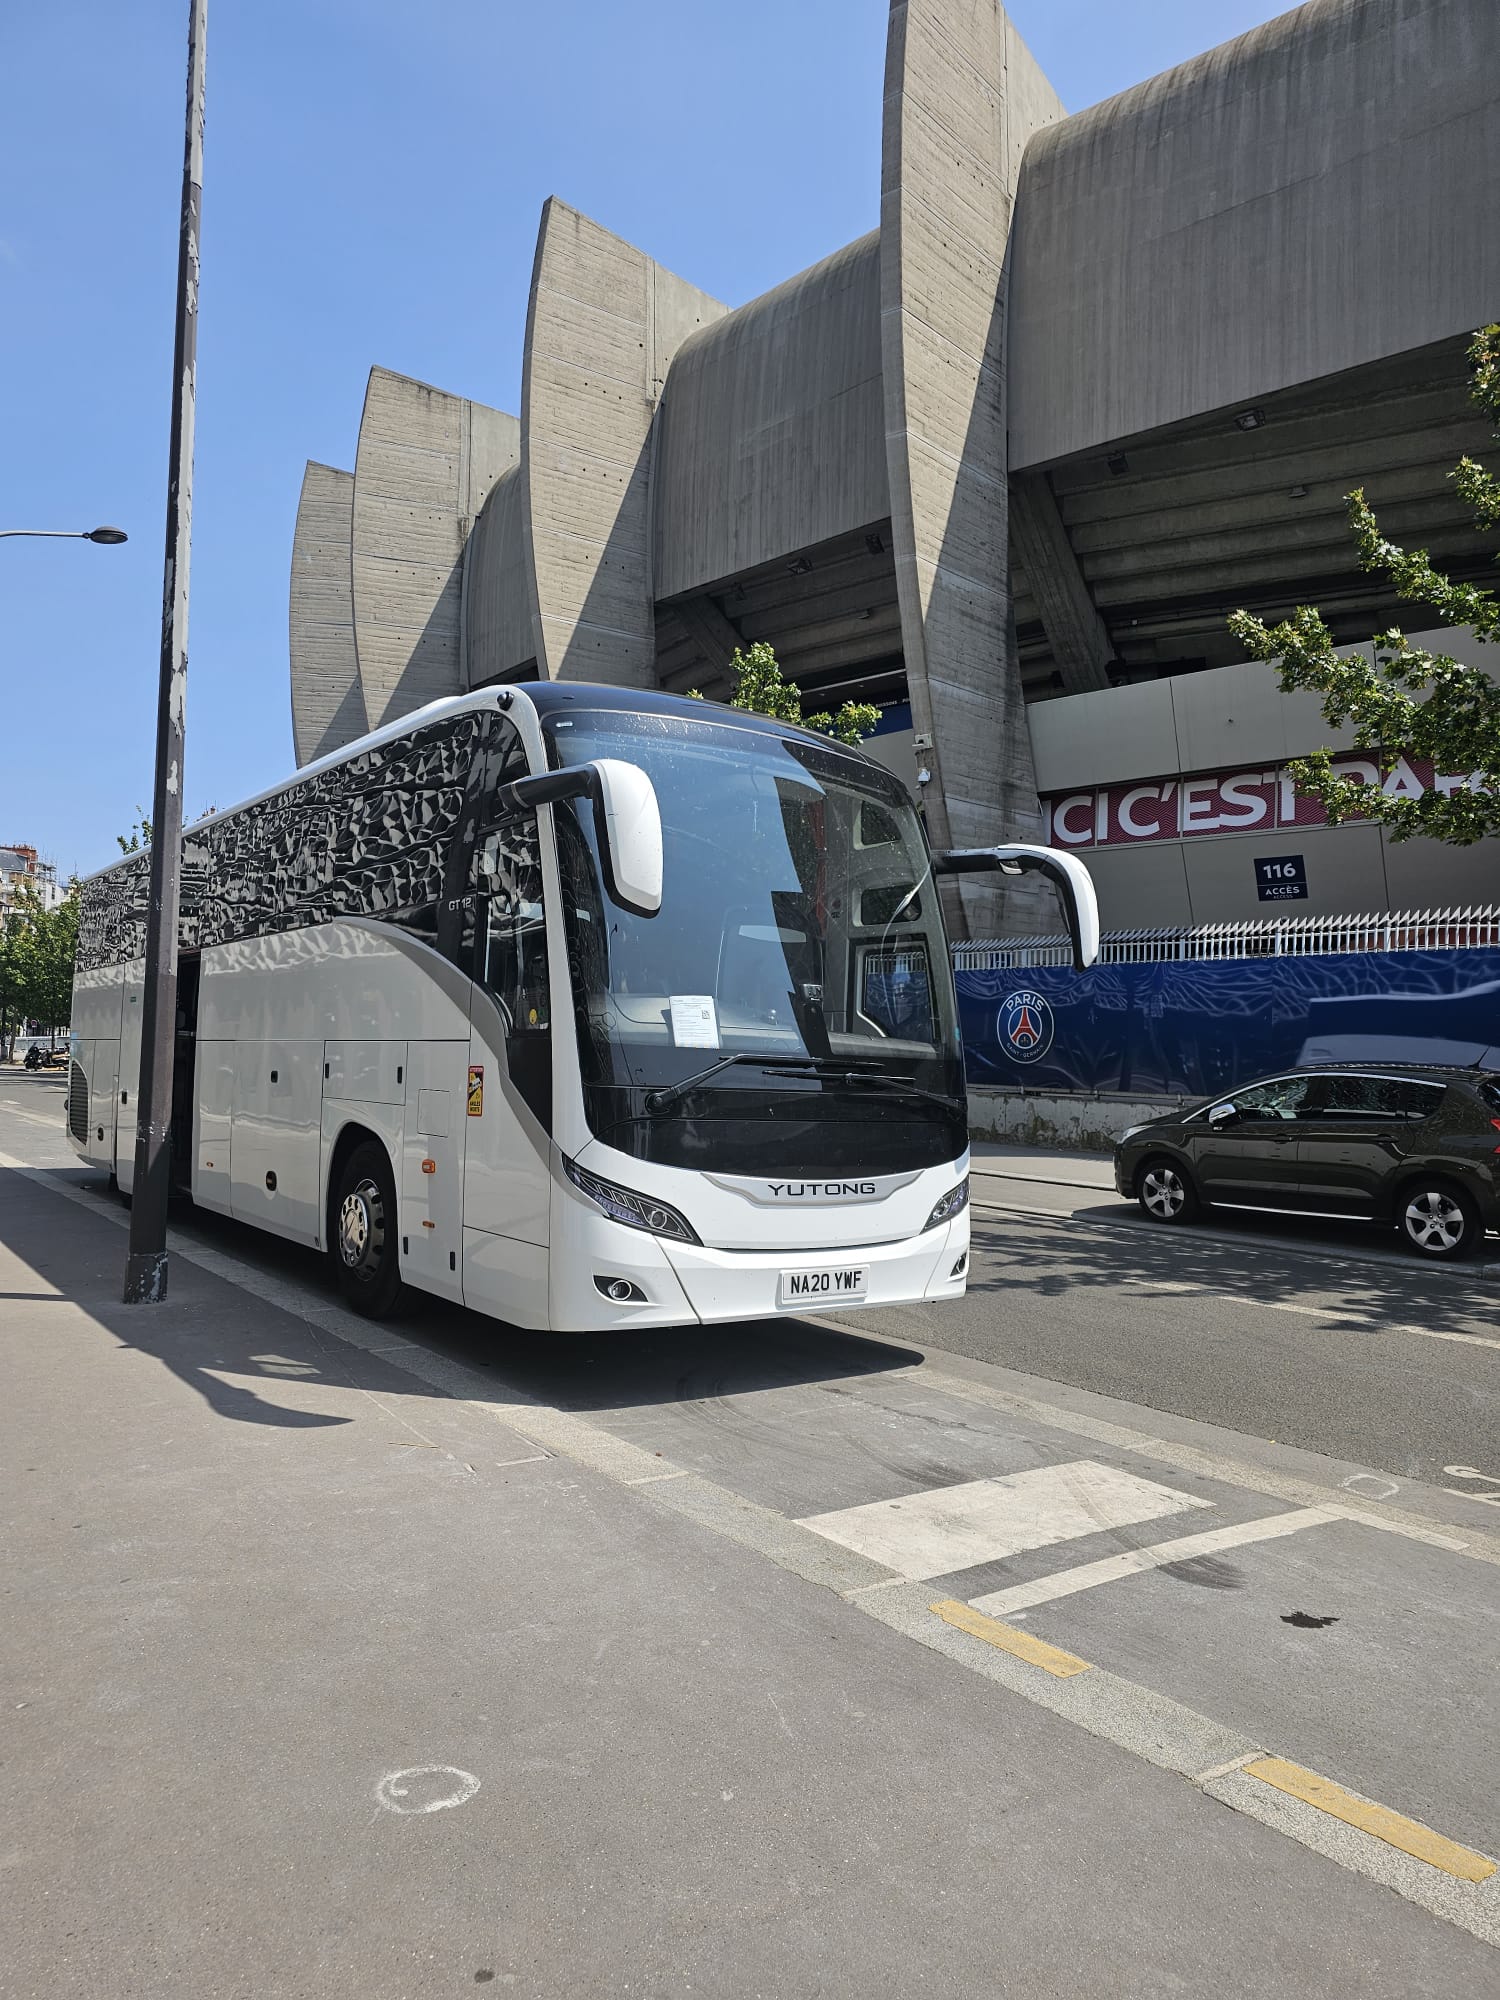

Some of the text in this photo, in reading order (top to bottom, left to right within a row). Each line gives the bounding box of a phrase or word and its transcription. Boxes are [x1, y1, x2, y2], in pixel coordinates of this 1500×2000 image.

[1117, 770, 1299, 837] C'EST
[1263, 862, 1296, 879] 116
[1265, 885, 1300, 895] ACCÈS
[1006, 993, 1045, 1011] PARIS
[768, 1182, 876, 1197] YUTONG
[791, 1270, 863, 1294] NA20 YWF
